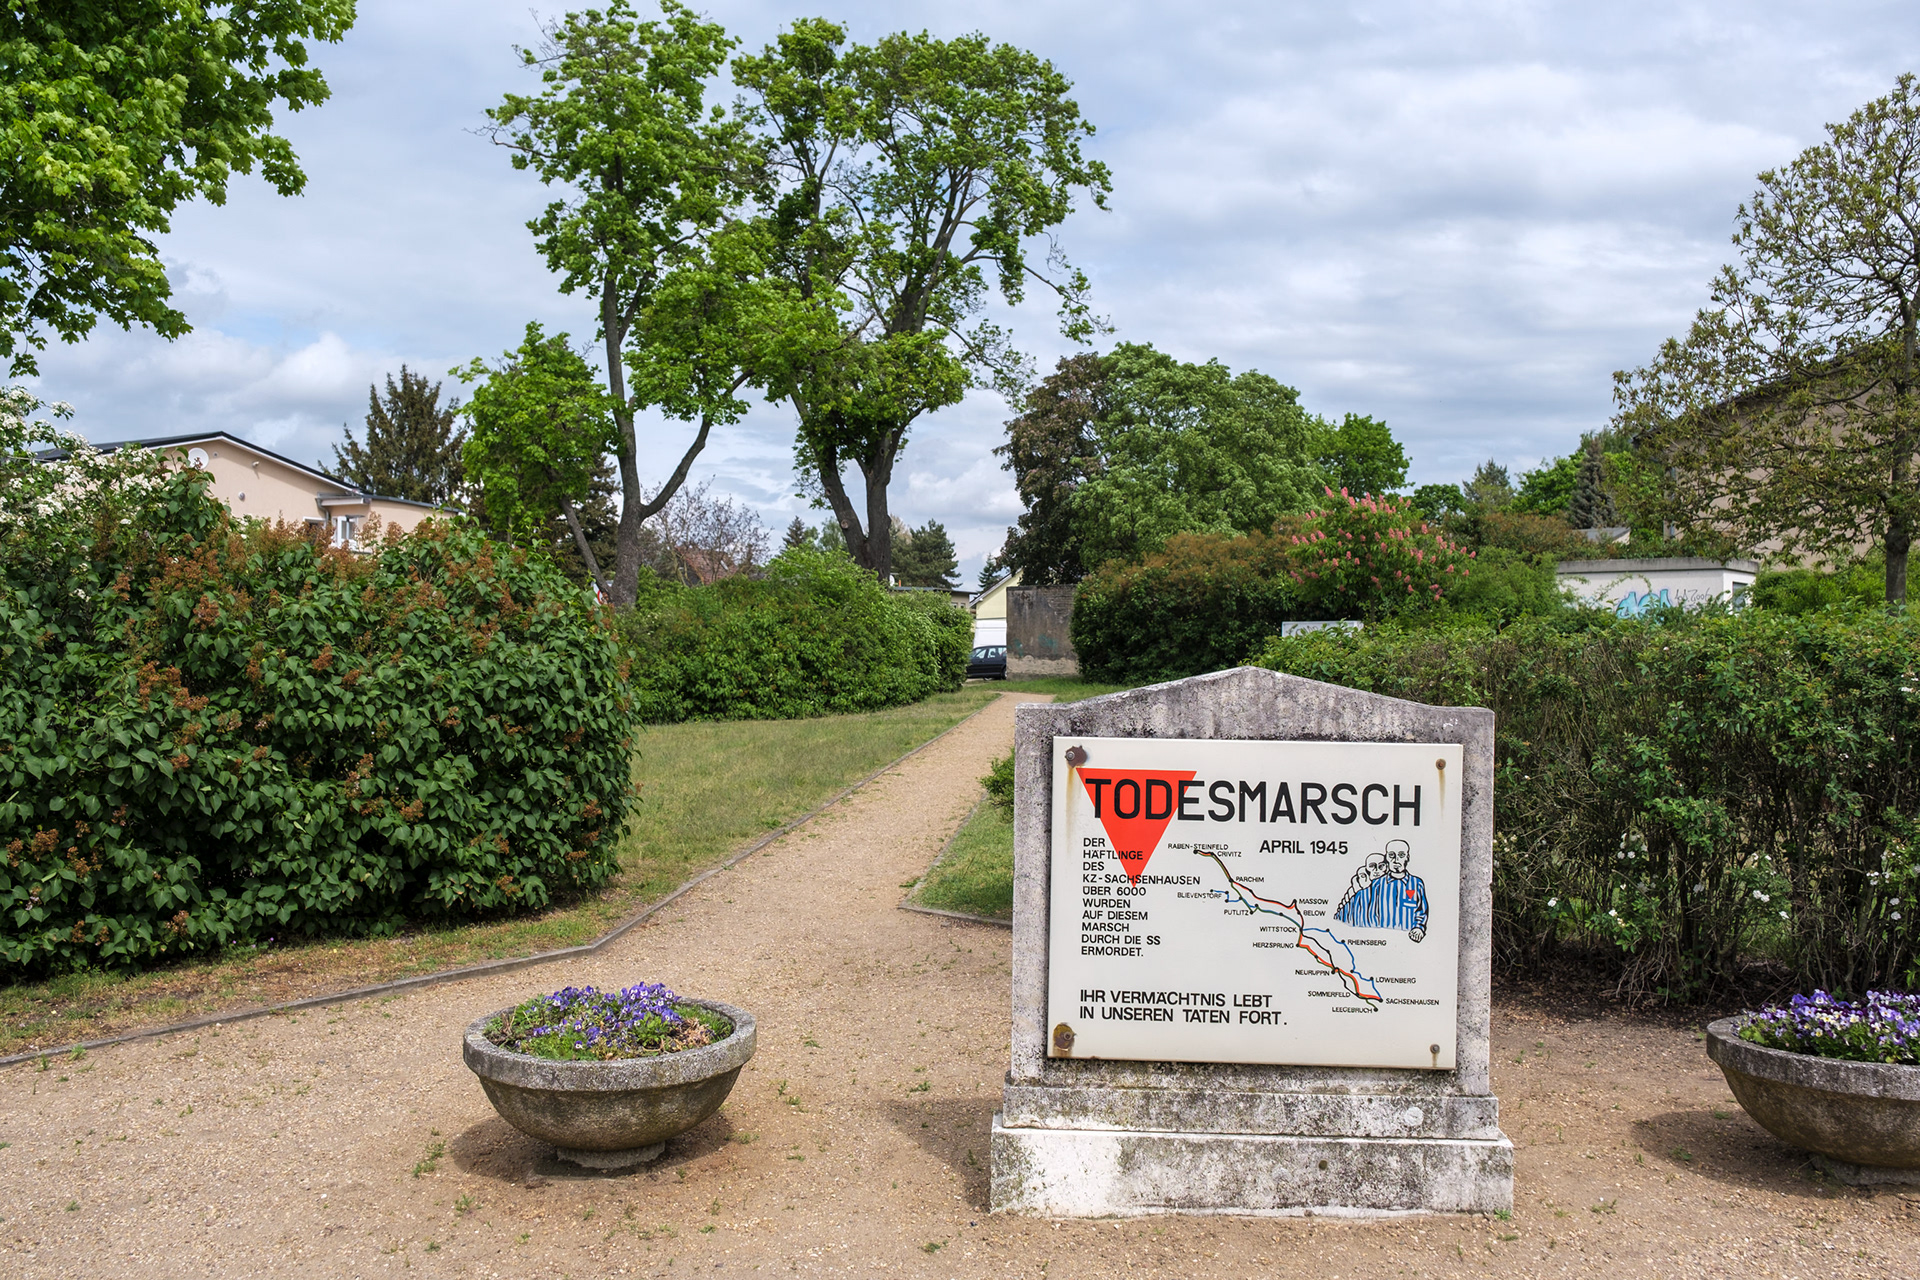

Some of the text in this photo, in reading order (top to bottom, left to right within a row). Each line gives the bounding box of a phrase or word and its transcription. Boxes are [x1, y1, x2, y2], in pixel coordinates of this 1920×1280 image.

[1085, 778, 1422, 827] TODESMARSCH
[1083, 837, 1106, 847] DER
[1167, 843, 1229, 851] RABEN-STEINFELD
[1259, 840, 1349, 855] APRIL 1945
[1083, 849, 1143, 860] HÄFTLINGE
[1083, 861, 1105, 871] DES
[1082, 885, 1147, 896] ÜBER 6000
[1177, 891, 1223, 899] BLIEVENSTORF
[1082, 898, 1131, 908] WURDEN
[1082, 910, 1148, 920] AUF DIESEM
[1303, 909, 1326, 917] BELOW
[1081, 922, 1130, 932] MARSCH
[1081, 934, 1161, 945] DURCH DIE SS
[1347, 939, 1387, 947] RHEINSBERG
[1081, 946, 1144, 957] ERMORDET.
[1080, 989, 1273, 1008] IHR VERMÄCHTNIS LEBT
[1307, 990, 1351, 998] SOMMERFELD
[1385, 998, 1440, 1006] SACHSENHAUSEN
[1079, 1006, 1288, 1025] IN UNSEREN TATEN FORT.
